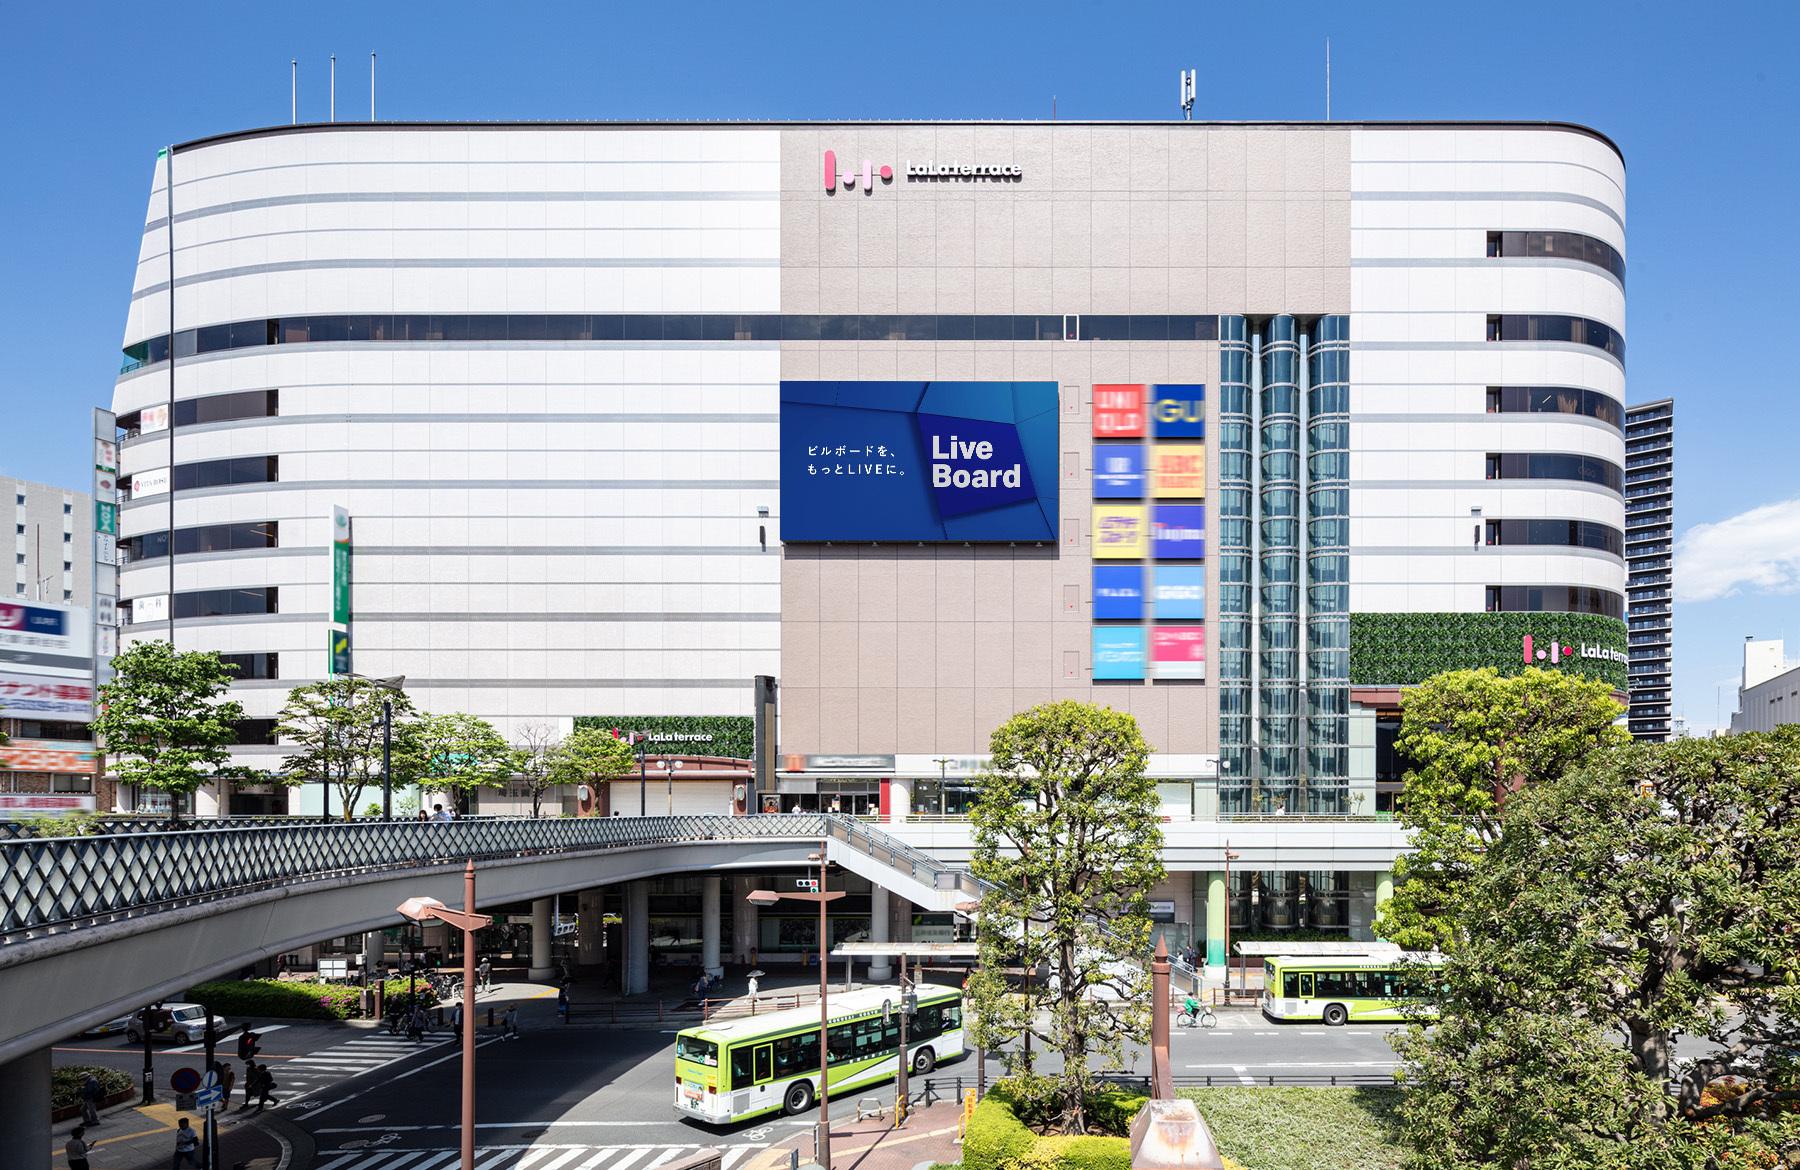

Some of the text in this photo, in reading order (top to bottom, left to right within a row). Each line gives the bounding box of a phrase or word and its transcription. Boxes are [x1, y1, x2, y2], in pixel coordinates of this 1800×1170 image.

[807, 444, 896, 458] ビルボードを、
[932, 435, 993, 460] Live
[807, 463, 906, 476] もっとLIVEに。
[932, 464, 1021, 488] Board
